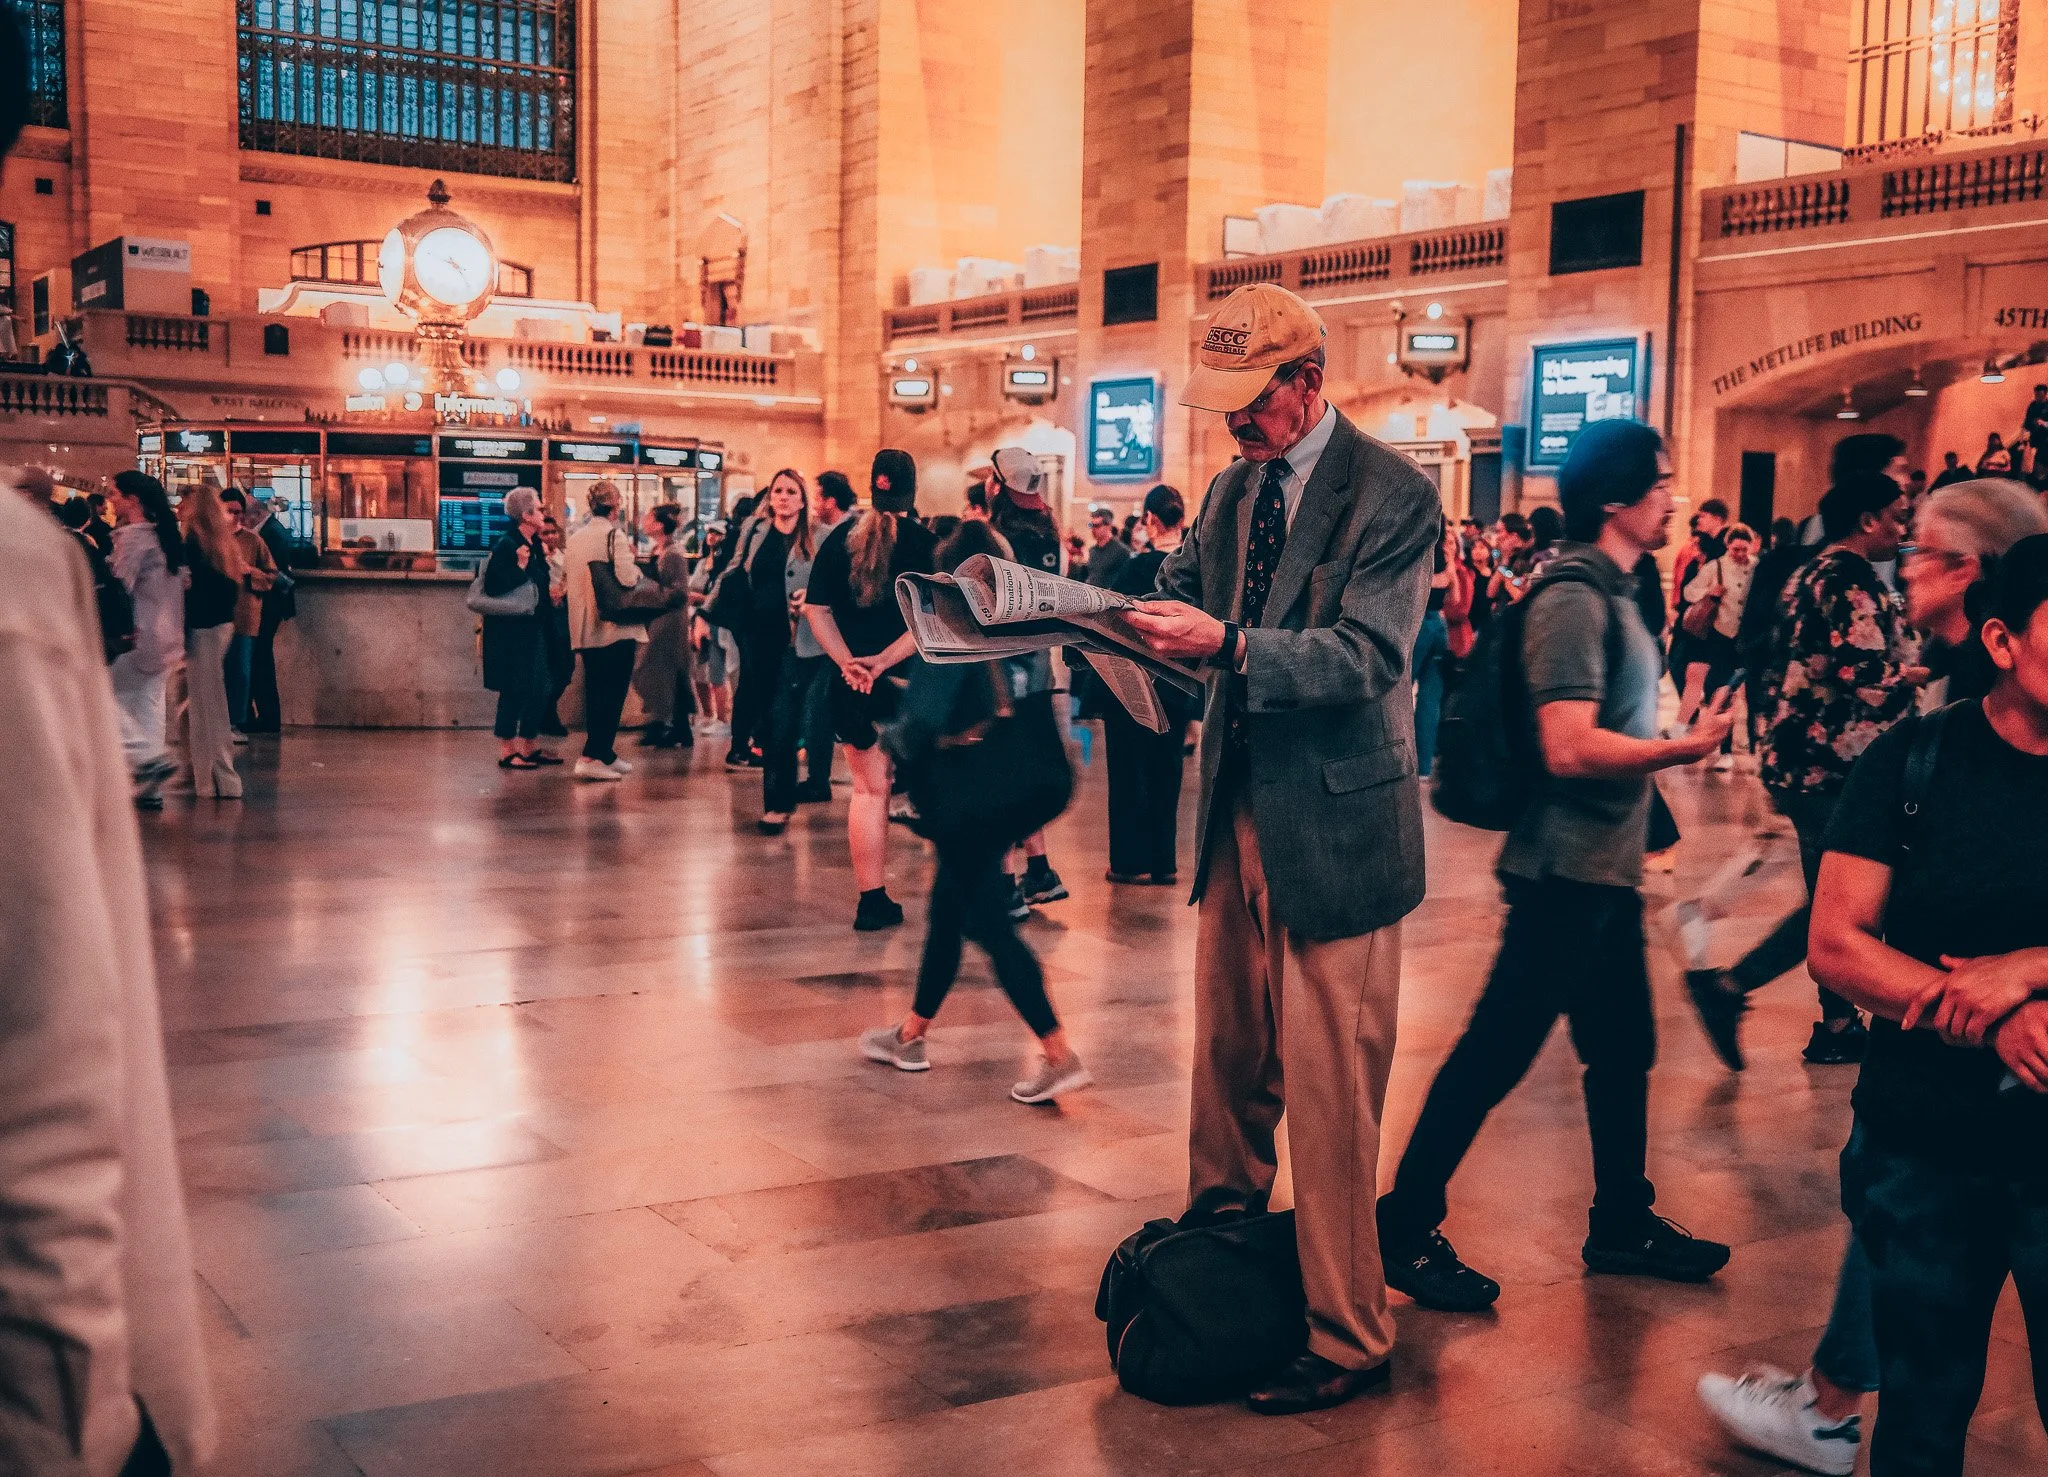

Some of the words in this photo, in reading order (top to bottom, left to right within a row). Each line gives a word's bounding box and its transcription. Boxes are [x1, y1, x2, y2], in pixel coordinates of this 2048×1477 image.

[1712, 365, 1746, 395] THE
[1750, 333, 1825, 377] METLIFE
[1830, 312, 1922, 348] BUILDING
[1002, 568, 1014, 620] International
